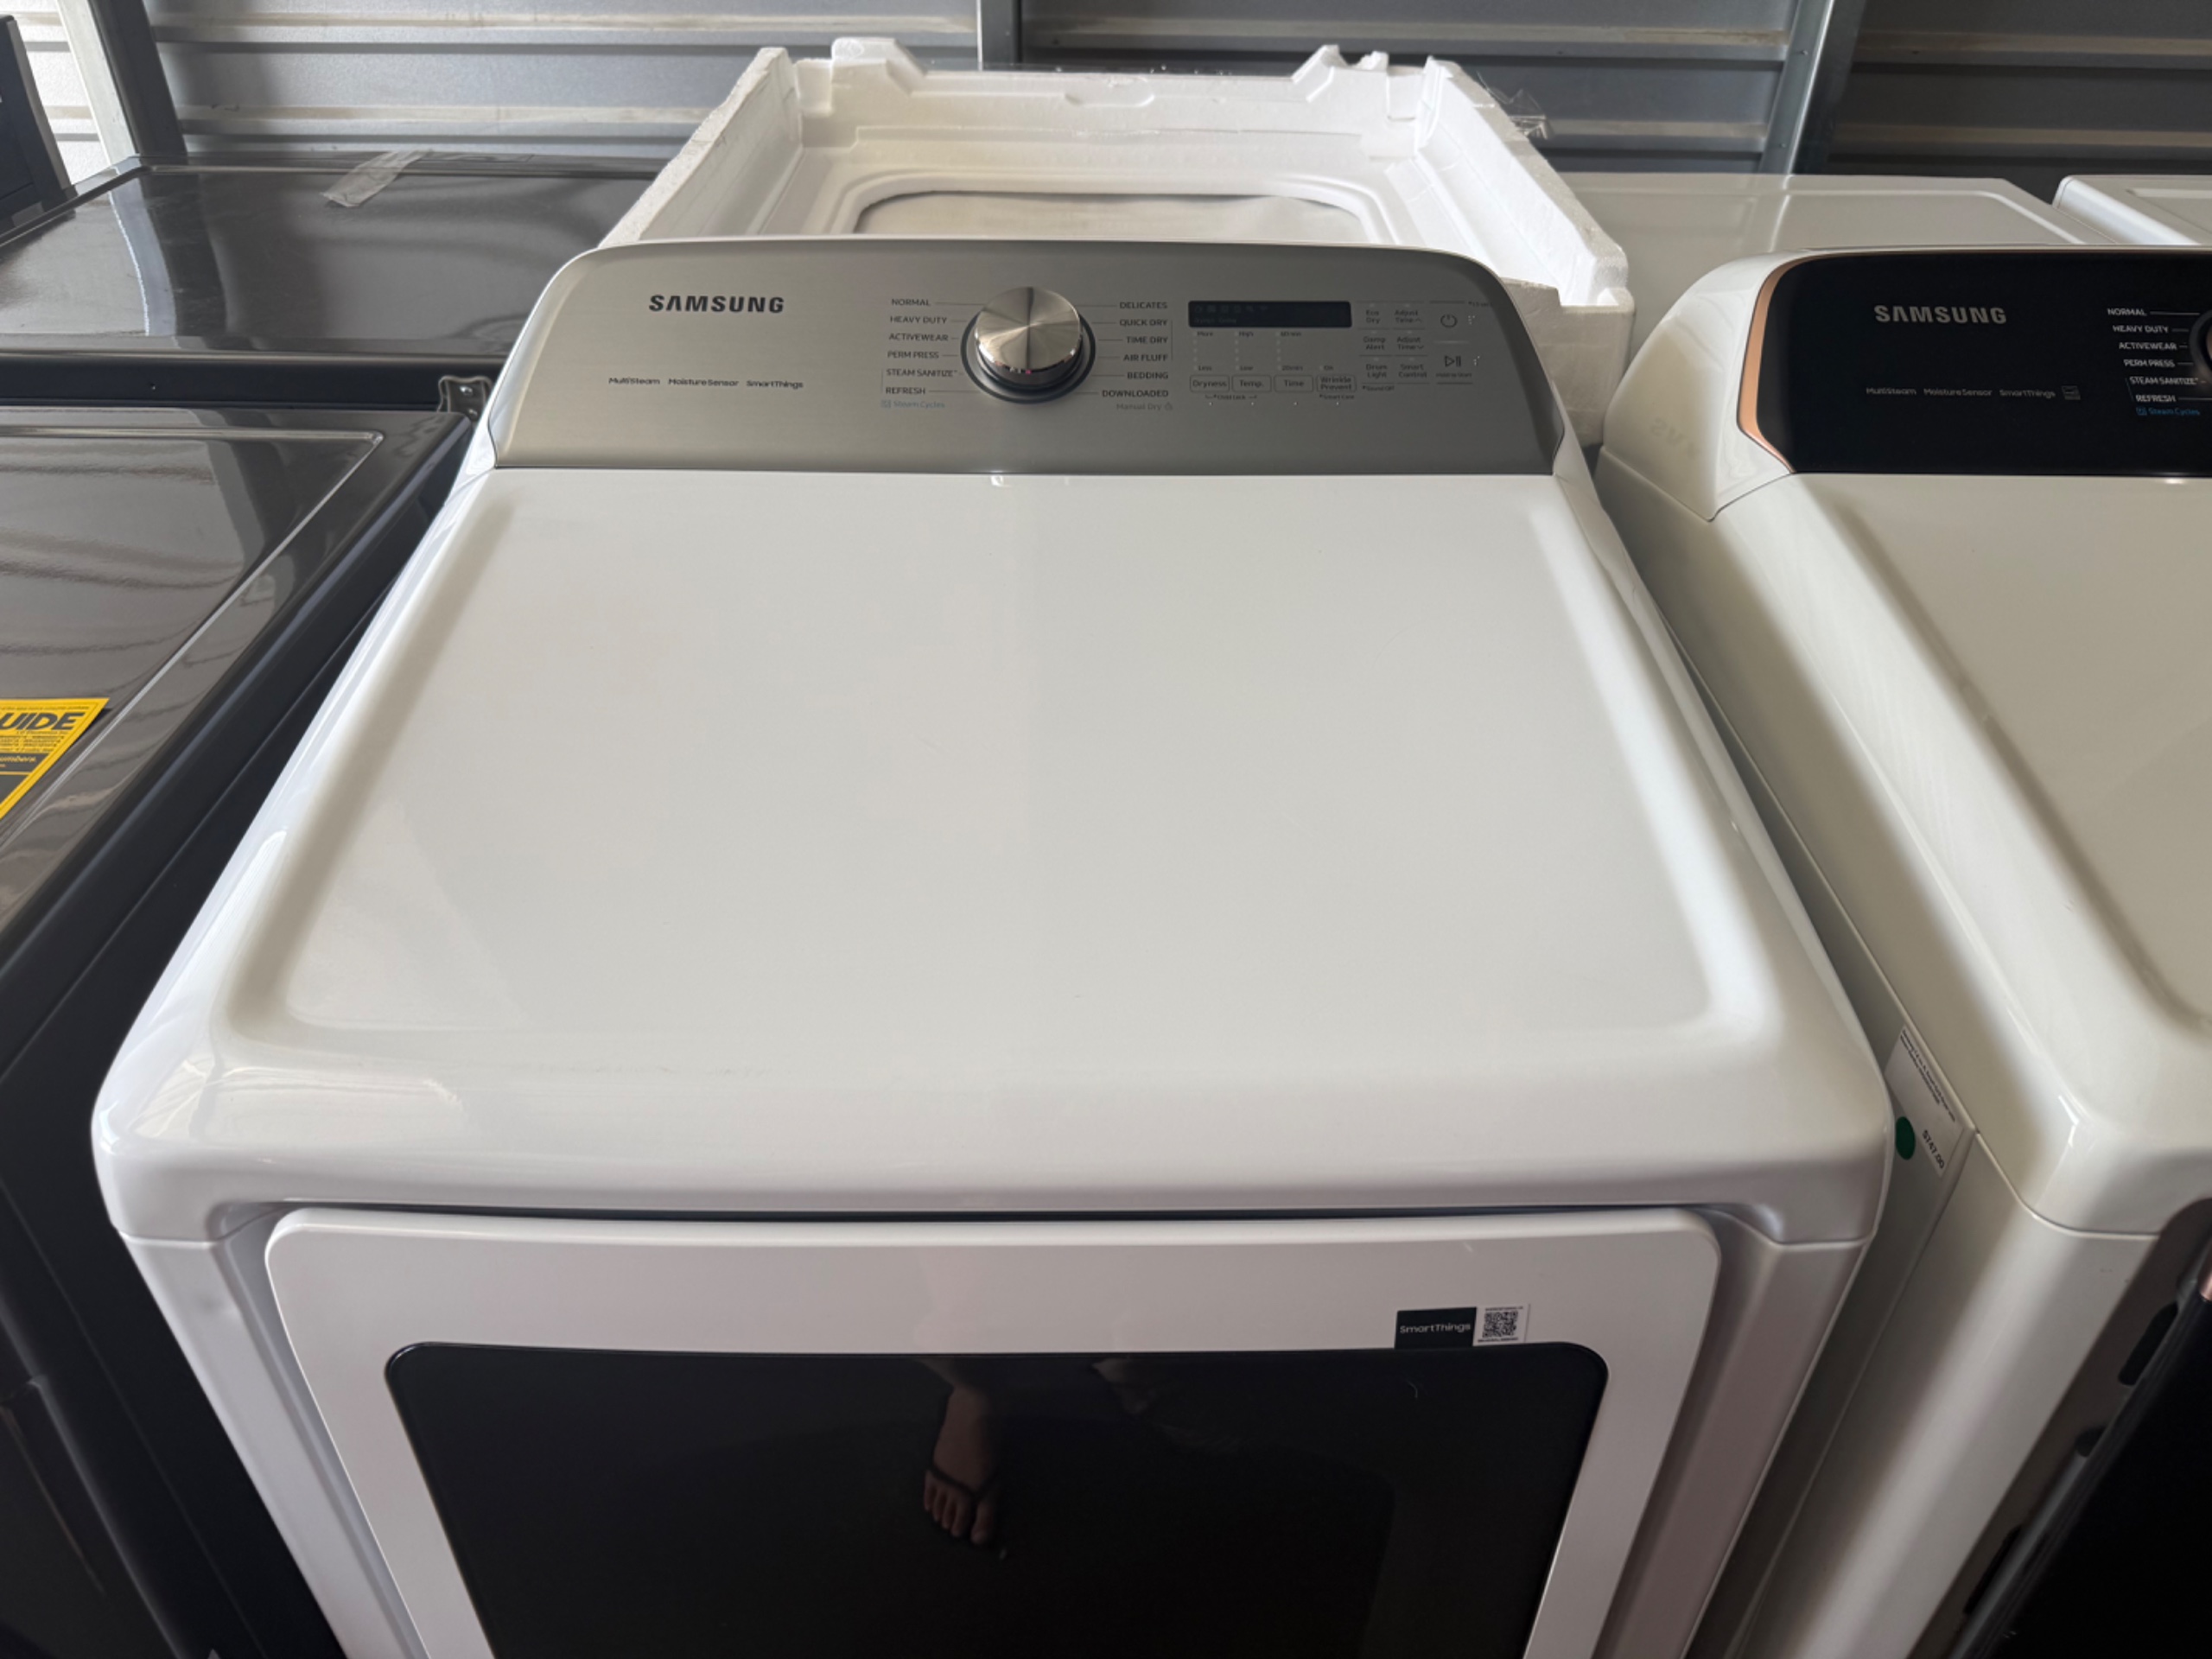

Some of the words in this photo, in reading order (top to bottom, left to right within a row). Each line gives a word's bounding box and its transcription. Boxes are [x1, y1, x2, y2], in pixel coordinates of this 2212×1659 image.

[648, 295, 785, 314] SAMSUNG
[891, 298, 931, 307] NORMAL
[1873, 305, 2007, 324] SAMSUNG
[2107, 308, 2147, 317] NORMAL
[1119, 319, 1147, 327] QUICK
[2112, 325, 2143, 334] HEAVY
[2145, 325, 2170, 334] DUTY
[888, 334, 949, 342] ACTIVEWEAR
[2123, 359, 2148, 367] PERM
[2148, 359, 2176, 368] PRESS
[886, 368, 916, 377] STEAM
[1127, 371, 1169, 379] BEDDING
[668, 378, 707, 386] Moisture
[708, 378, 740, 387] Sensor
[746, 379, 804, 390] SmartThings
[1192, 379, 1228, 388] Dryness
[2129, 376, 2158, 385] STEAM
[885, 386, 926, 395] REFRESH
[1102, 389, 1169, 397] DOWNLOADED
[2135, 394, 2177, 403] REFRESH
[919, 401, 945, 410] Cycles
[1147, 402, 1163, 411] Dry
[1922, 1129, 1945, 1169] $747.00
[1399, 1322, 1471, 1335] SmartThings
